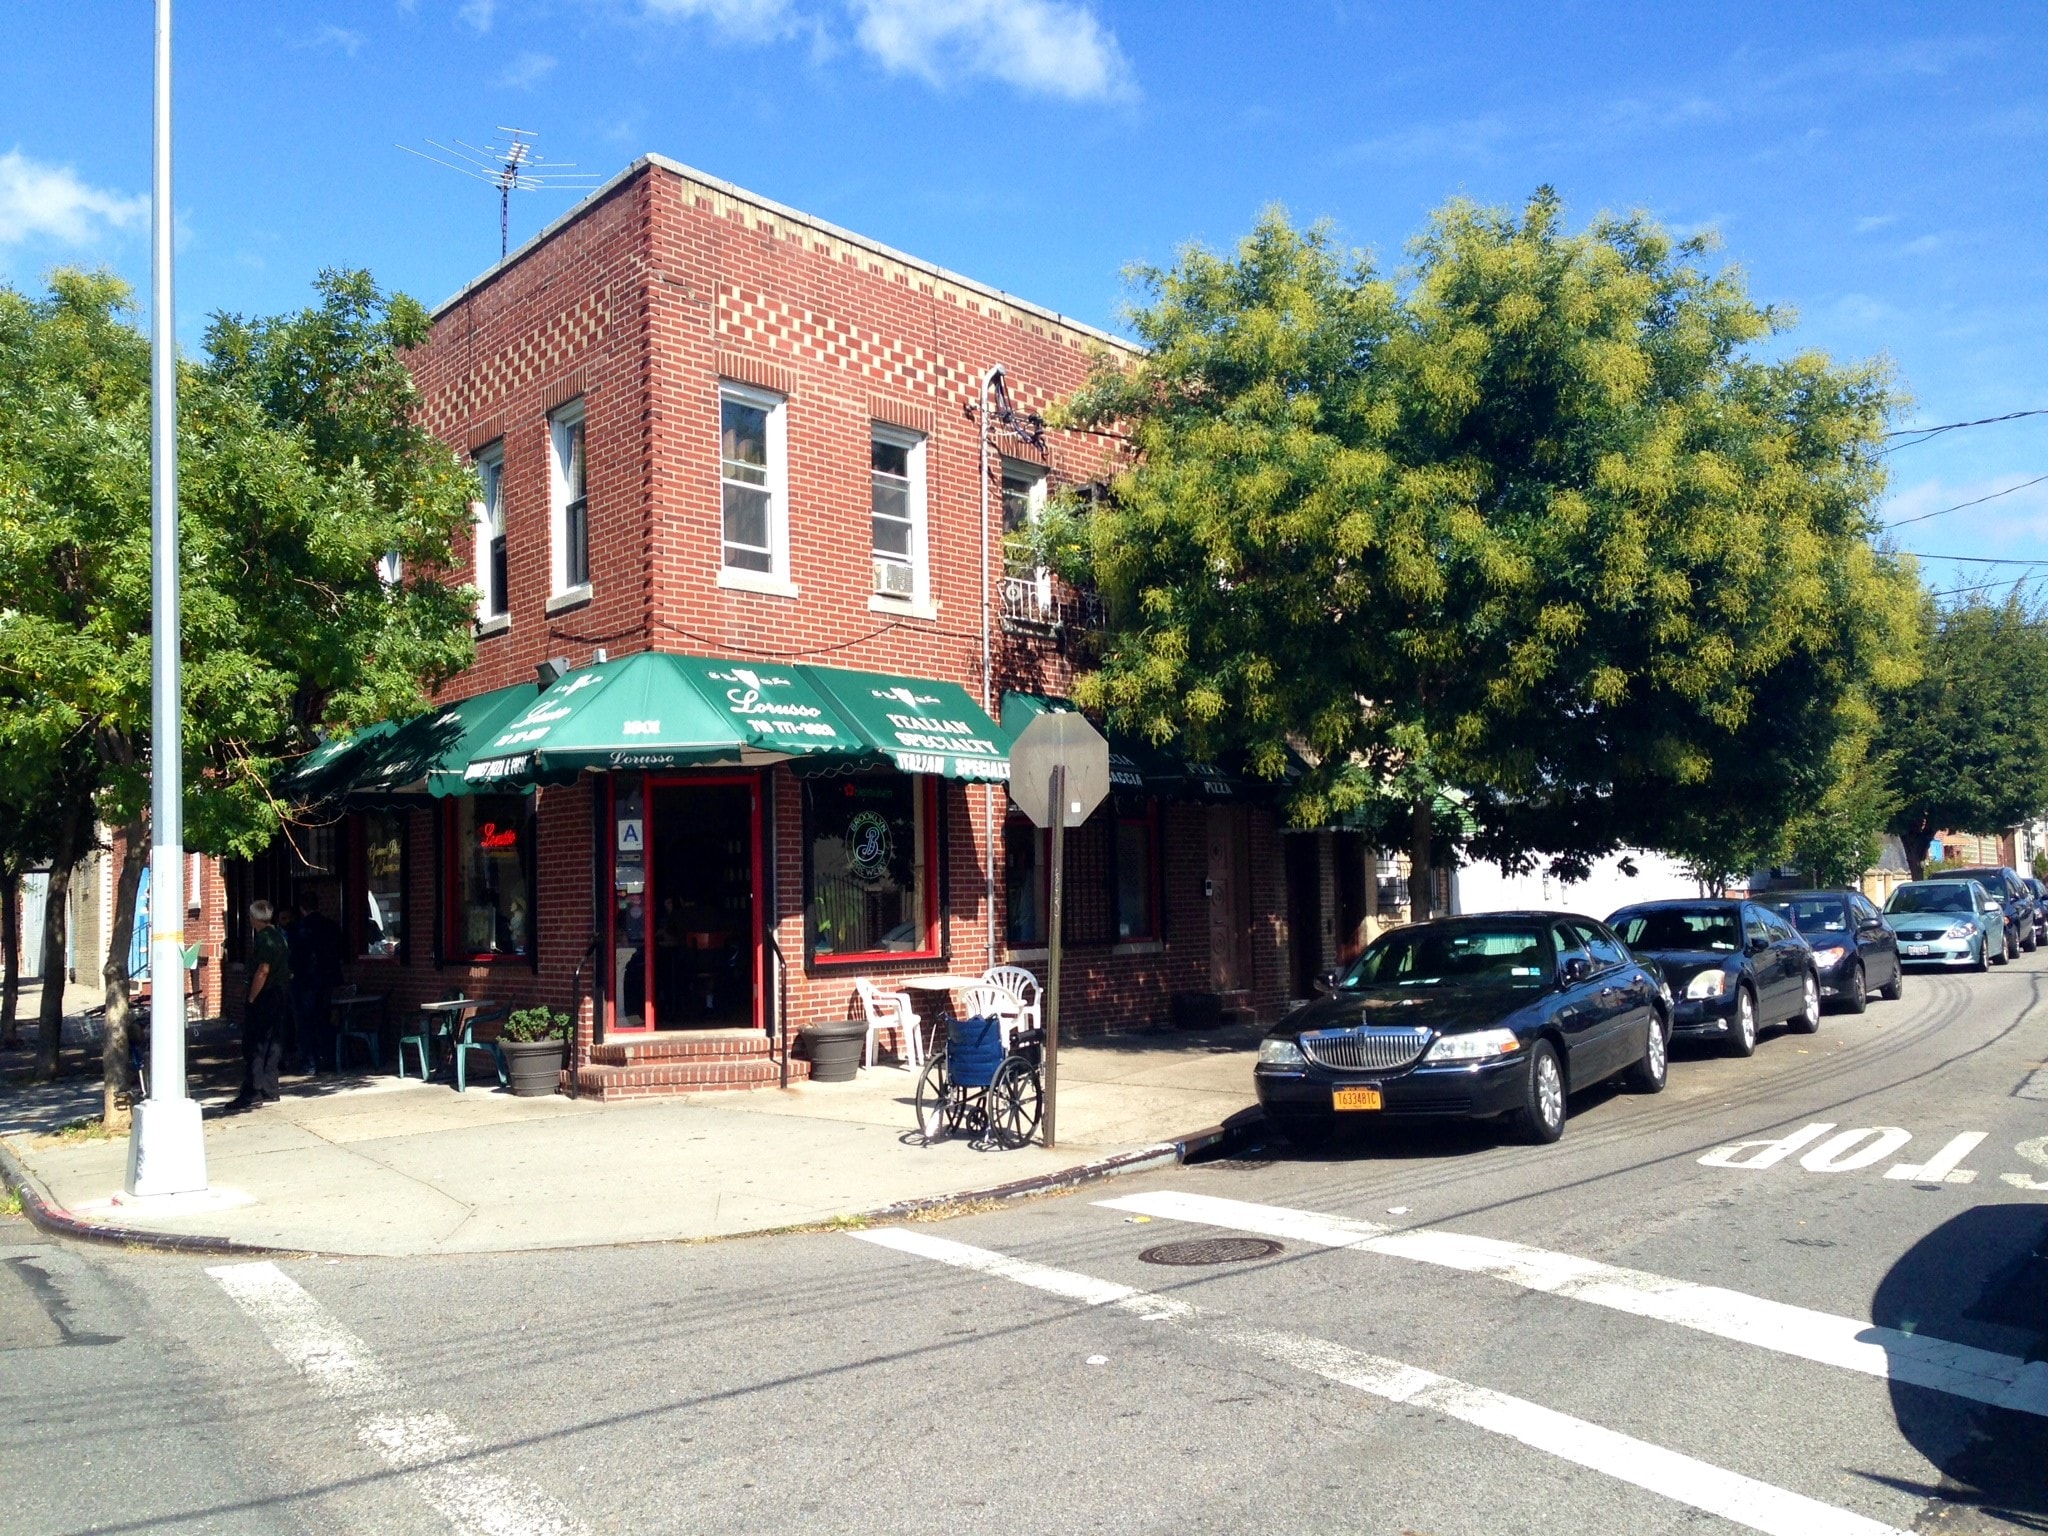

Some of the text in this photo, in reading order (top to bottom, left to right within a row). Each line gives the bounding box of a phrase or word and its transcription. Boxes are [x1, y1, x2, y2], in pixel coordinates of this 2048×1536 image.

[727, 689, 821, 717] Lorusso
[886, 714, 973, 734] ITALIAN
[895, 732, 999, 754] SPECIALTY
[609, 751, 674, 764] Lorusso
[896, 752, 1010, 778] ITALIAN SPECIALT
[1109, 770, 1143, 787] ACCIA
[1204, 781, 1233, 795] PIZZA
[623, 823, 639, 842] A
[850, 812, 887, 833] BROOKLYN
